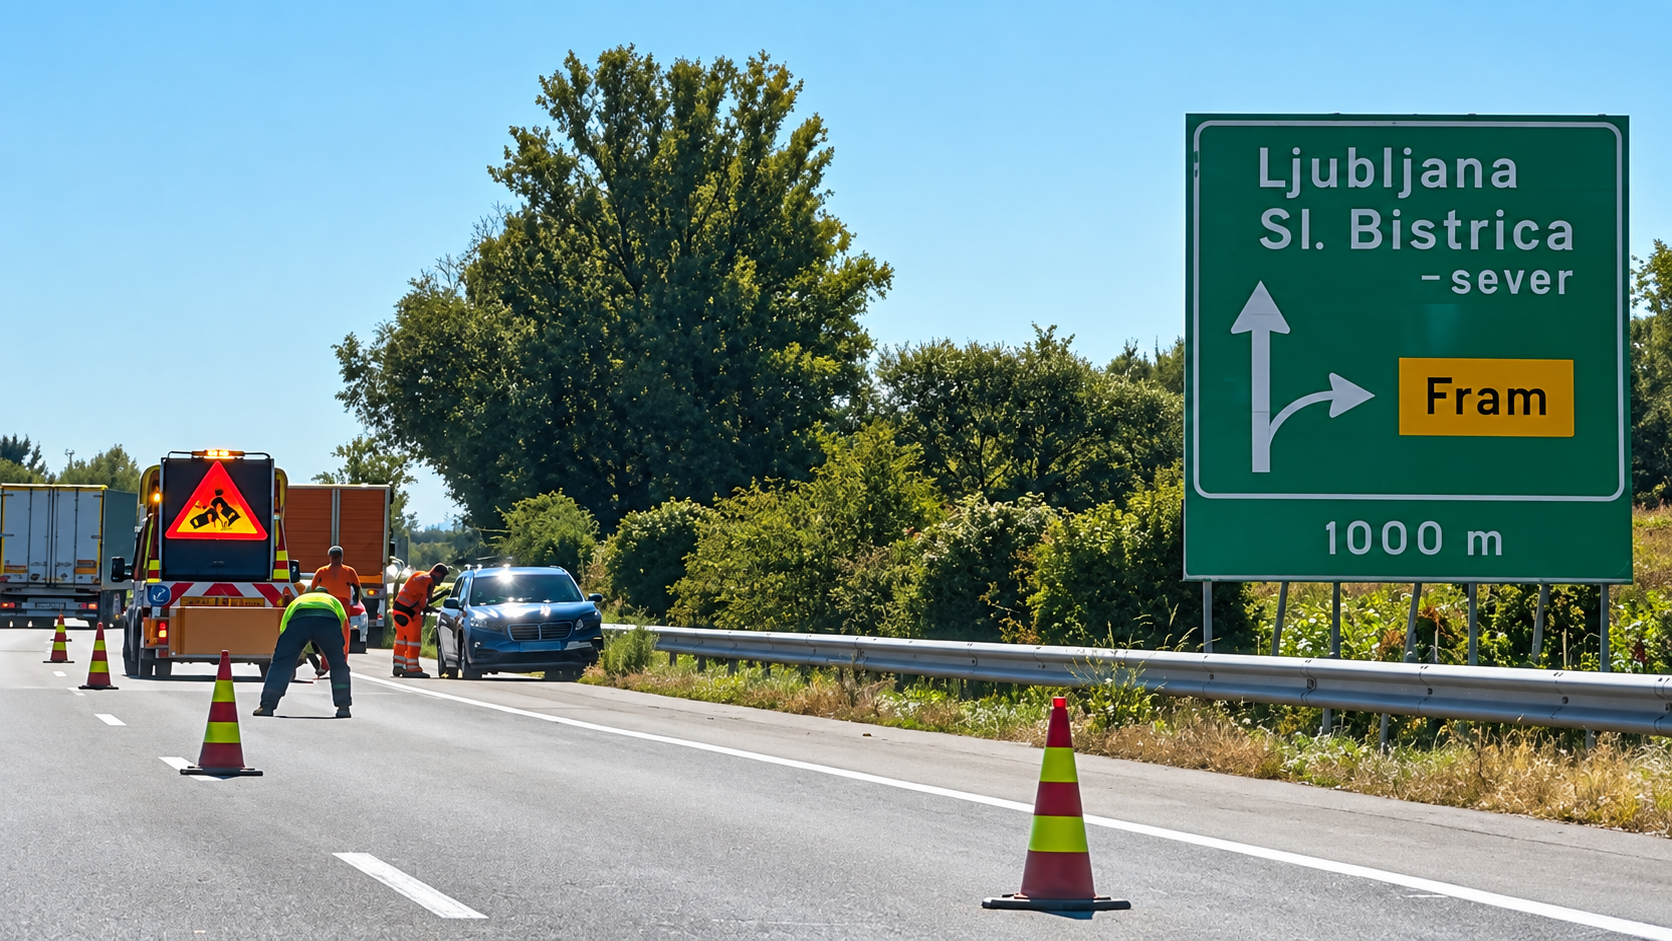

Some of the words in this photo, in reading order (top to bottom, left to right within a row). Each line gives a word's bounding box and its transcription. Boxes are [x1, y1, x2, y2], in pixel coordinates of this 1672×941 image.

[1260, 147, 1516, 198] Ljubljana
[1260, 208, 1323, 249] Sl.
[1351, 209, 1572, 250] Bistrica
[1428, 377, 1546, 415] Fram
[1326, 521, 1442, 555] 1000
[1468, 531, 1501, 555] m
